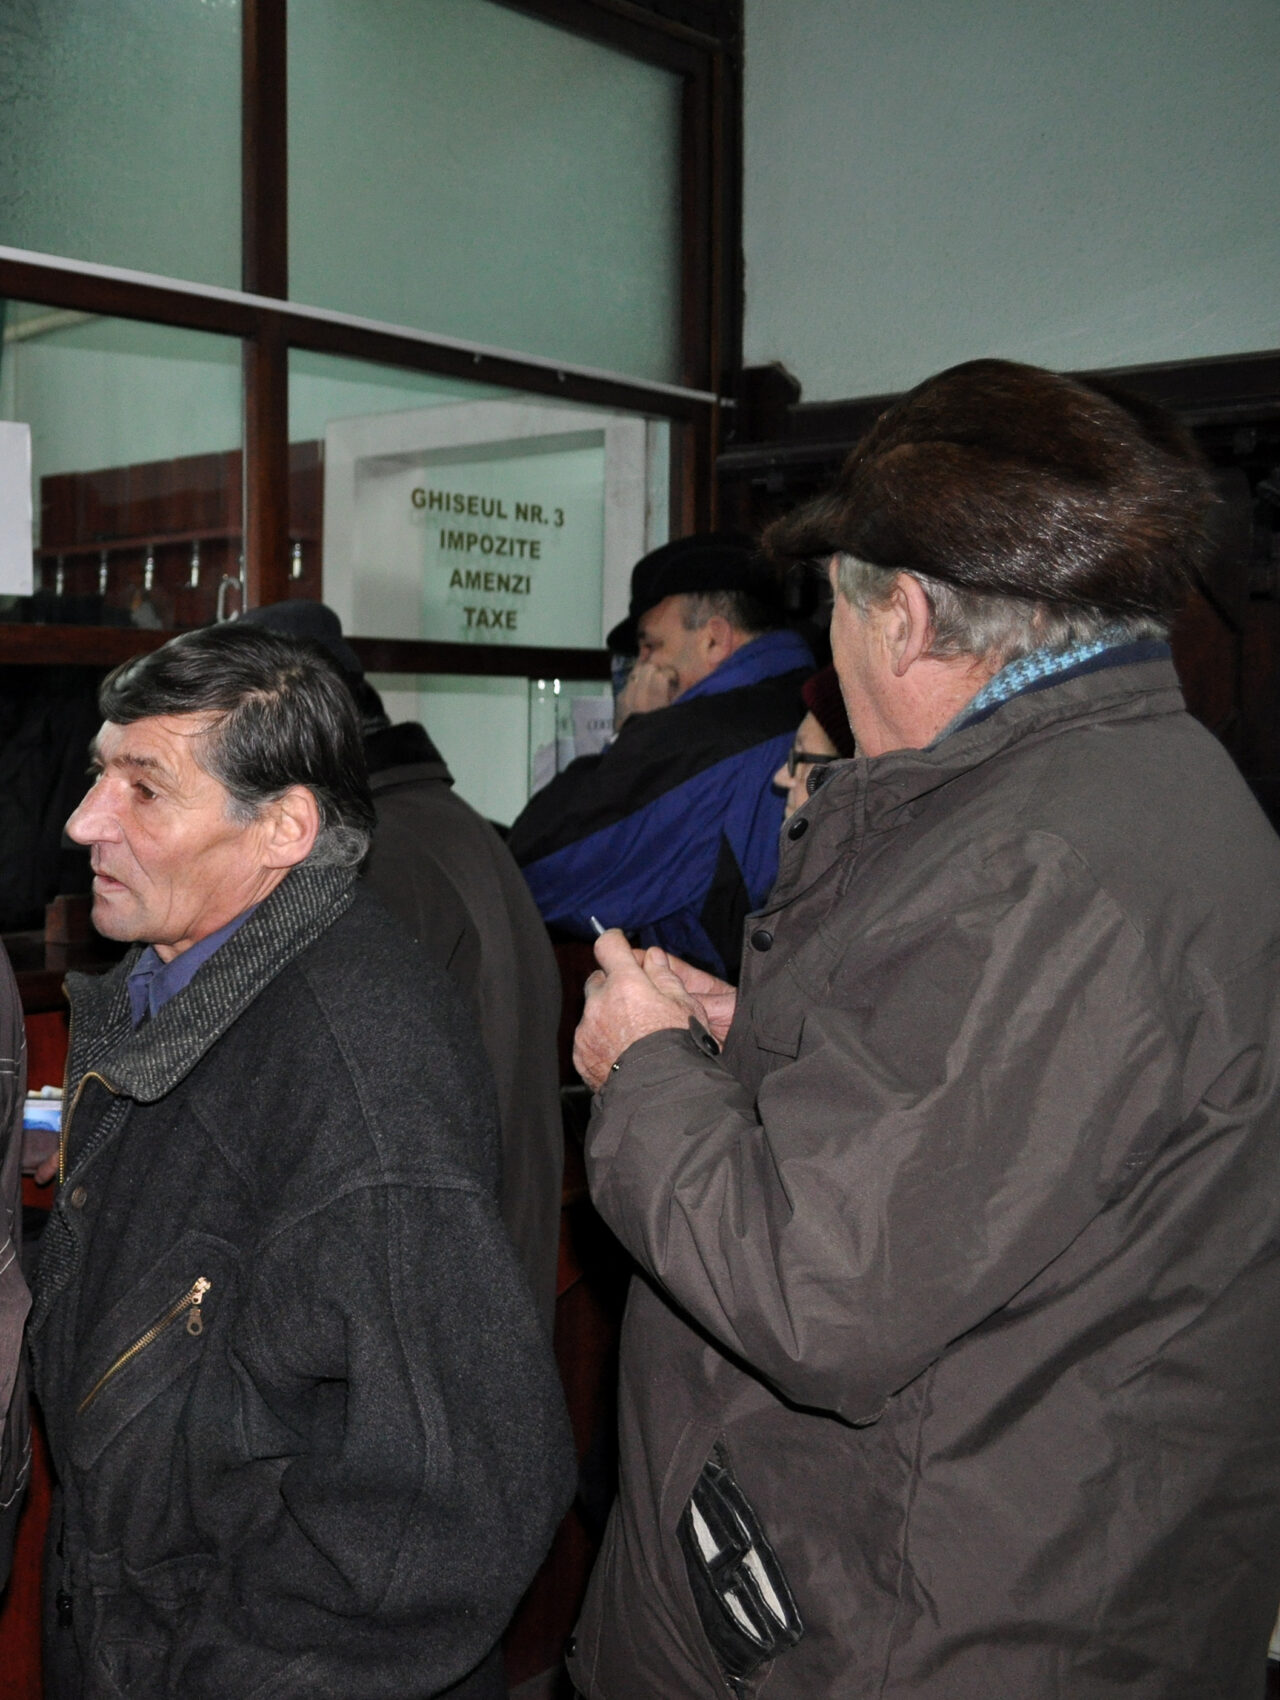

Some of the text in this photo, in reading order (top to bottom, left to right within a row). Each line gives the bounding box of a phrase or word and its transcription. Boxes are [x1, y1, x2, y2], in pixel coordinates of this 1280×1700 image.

[411, 487, 565, 528] GHISEUL NR. 3
[439, 529, 542, 560] IMPOZITE
[449, 568, 532, 595] AMENZI
[463, 606, 518, 631] TAXE
